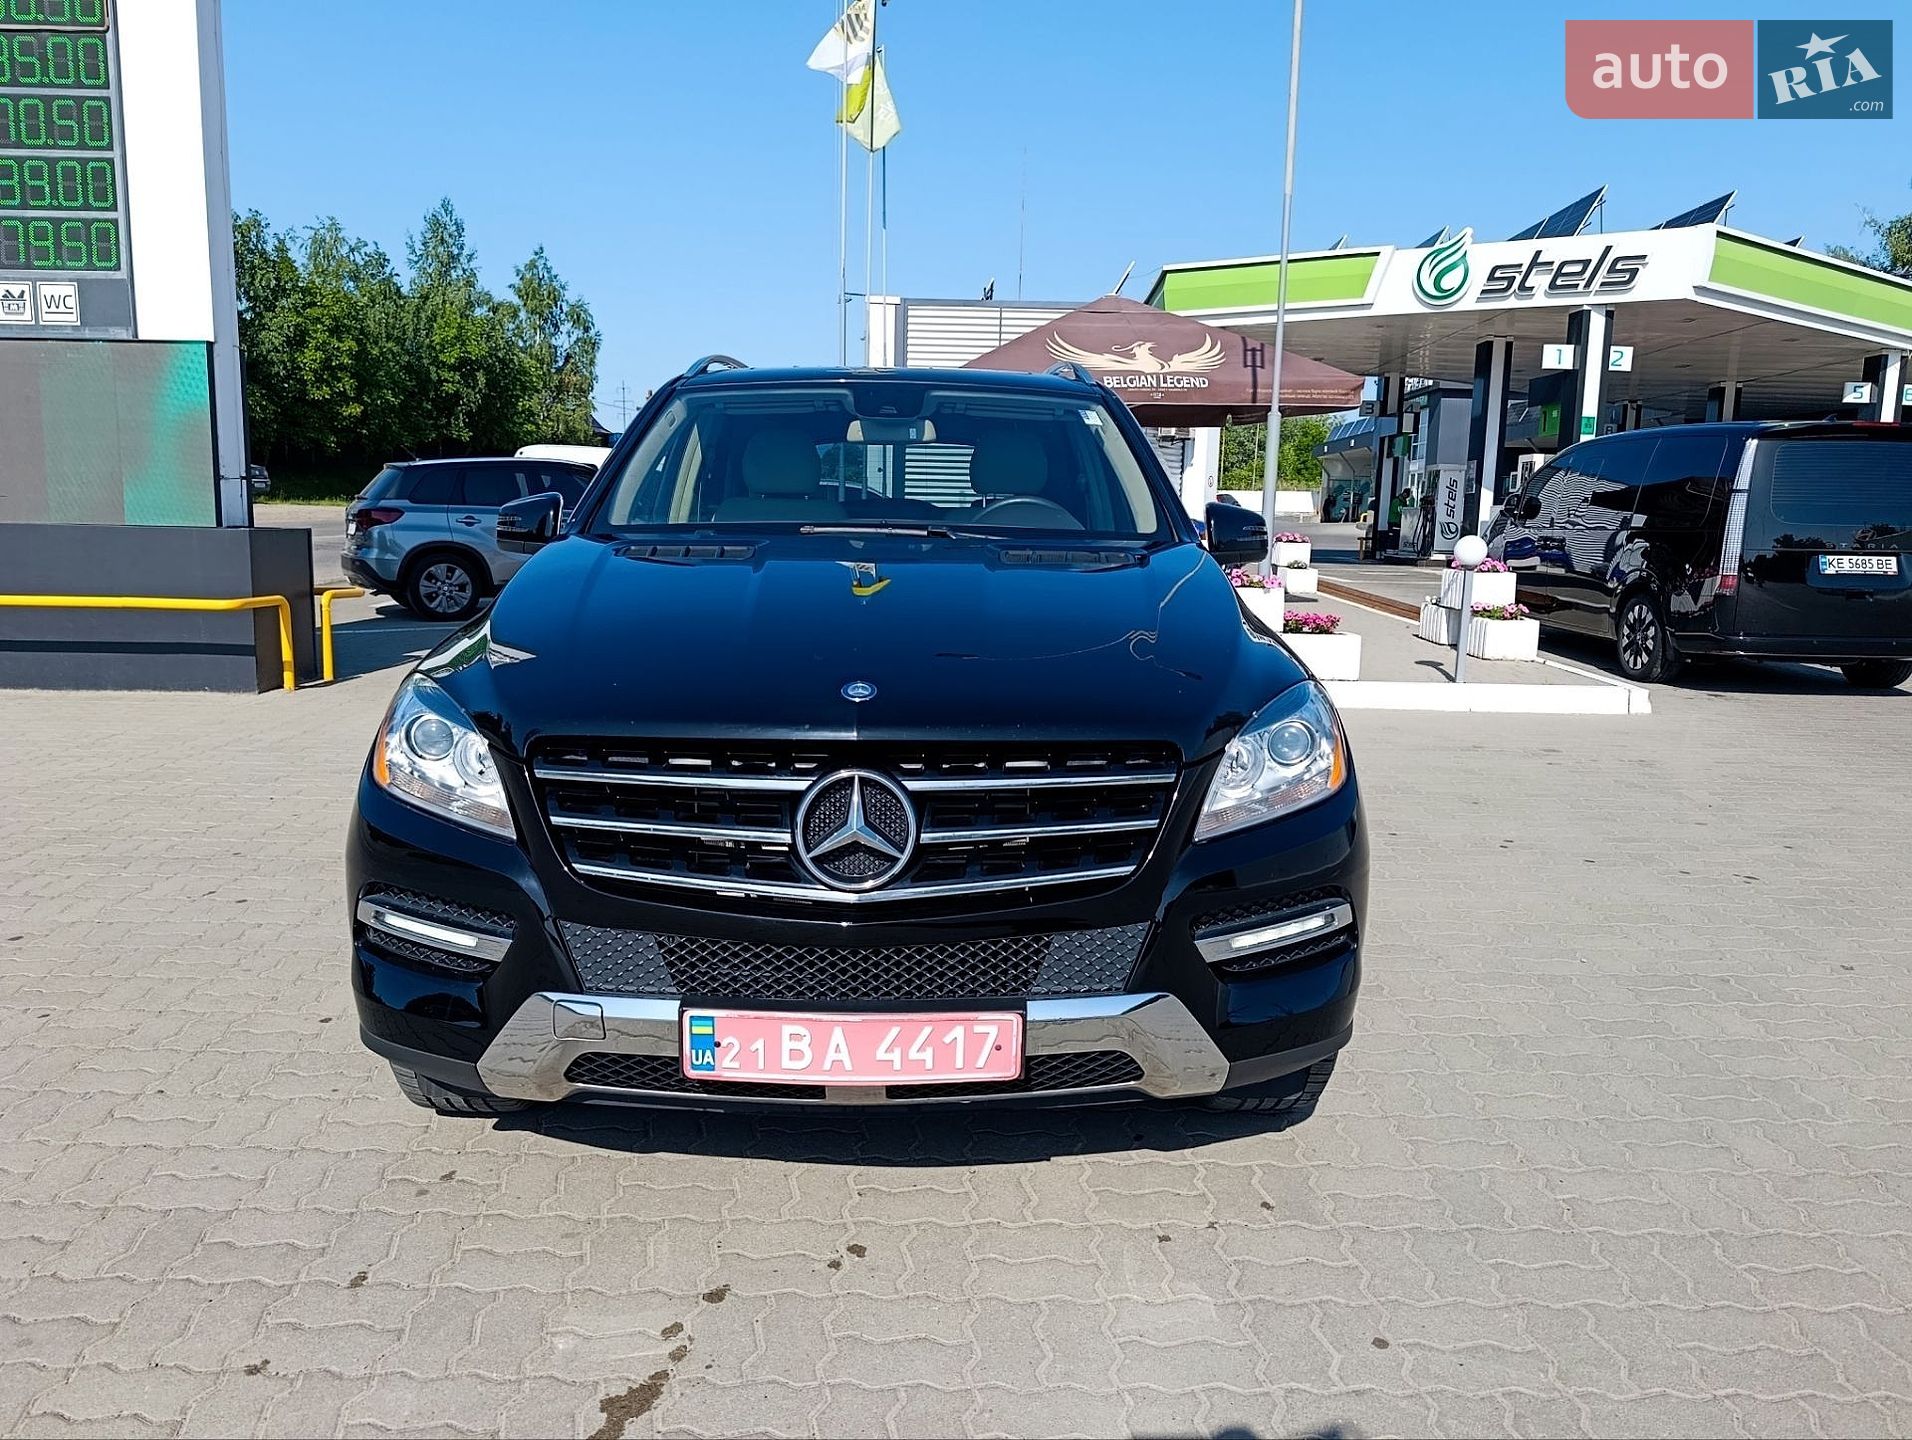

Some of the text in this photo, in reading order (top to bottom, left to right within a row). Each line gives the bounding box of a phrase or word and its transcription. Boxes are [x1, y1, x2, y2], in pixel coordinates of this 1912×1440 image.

[1, 219, 118, 268] 79.50
[1478, 245, 1649, 298] stels
[43, 294, 74, 310] WC
[1556, 349, 1562, 365] 1
[1610, 350, 1624, 367] 2
[1103, 374, 1209, 388] BELGIAN LEGEND
[1853, 385, 1864, 400] 5
[1365, 404, 1375, 414] 3
[1445, 476, 1458, 519] stels
[1827, 558, 1893, 570] KE 5685 BE
[721, 1024, 999, 1072] 21 BA 4417
[691, 1048, 715, 1066] UA
